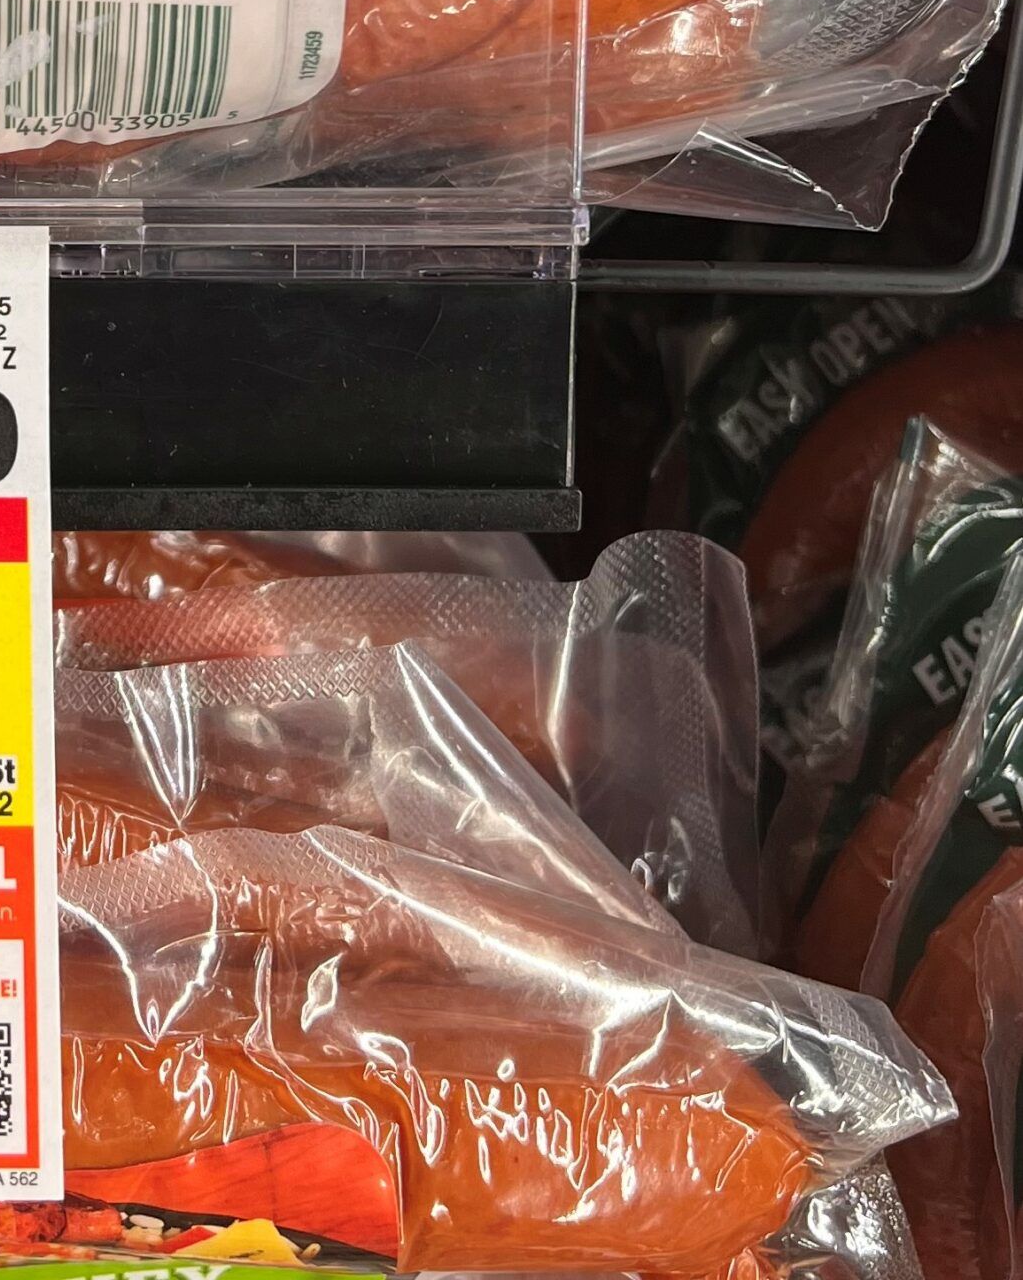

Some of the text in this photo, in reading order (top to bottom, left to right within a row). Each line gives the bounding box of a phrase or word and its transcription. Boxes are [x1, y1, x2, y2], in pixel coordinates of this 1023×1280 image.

[17, 111, 191, 135] 44500 33905
[9, 1171, 39, 1187] 562
